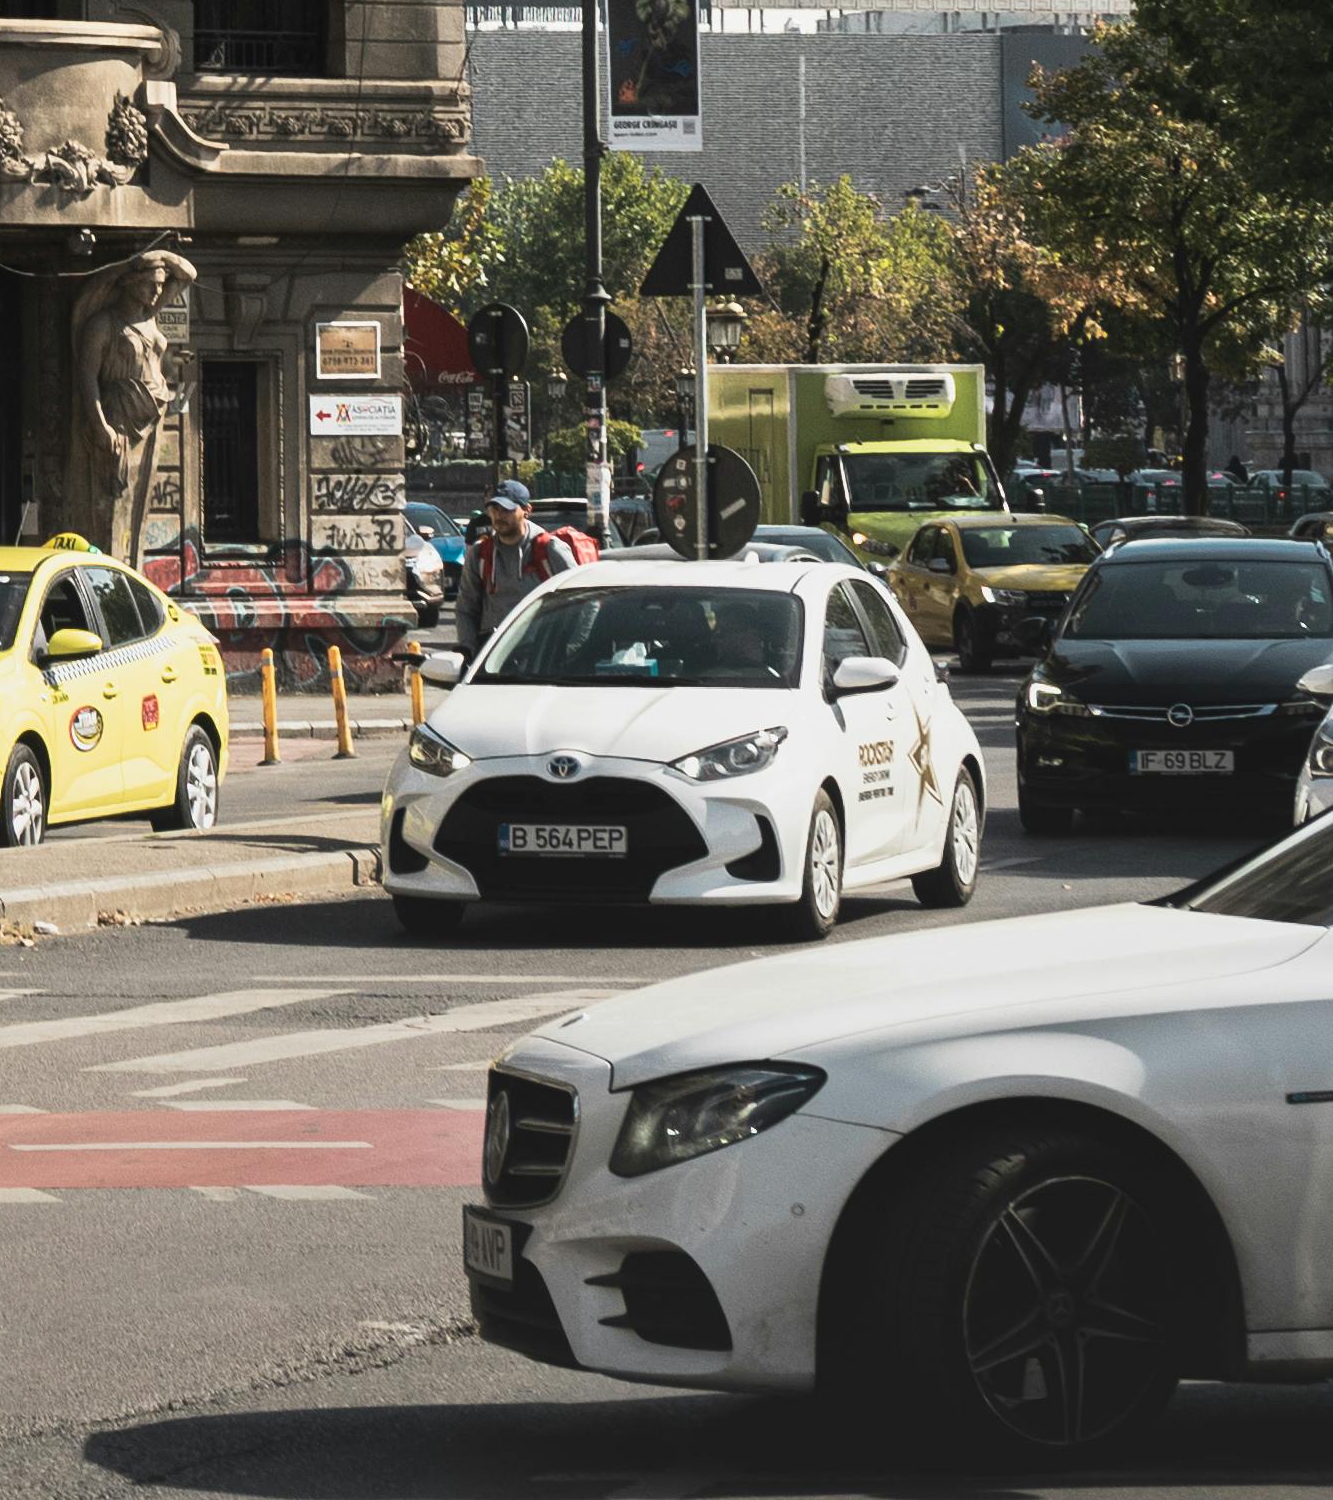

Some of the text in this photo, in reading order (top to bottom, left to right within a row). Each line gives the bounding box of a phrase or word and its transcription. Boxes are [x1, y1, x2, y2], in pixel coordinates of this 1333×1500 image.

[53, 537, 76, 551] TAXI
[1140, 751, 1227, 770] IF 69 BLZ
[511, 826, 528, 849] B
